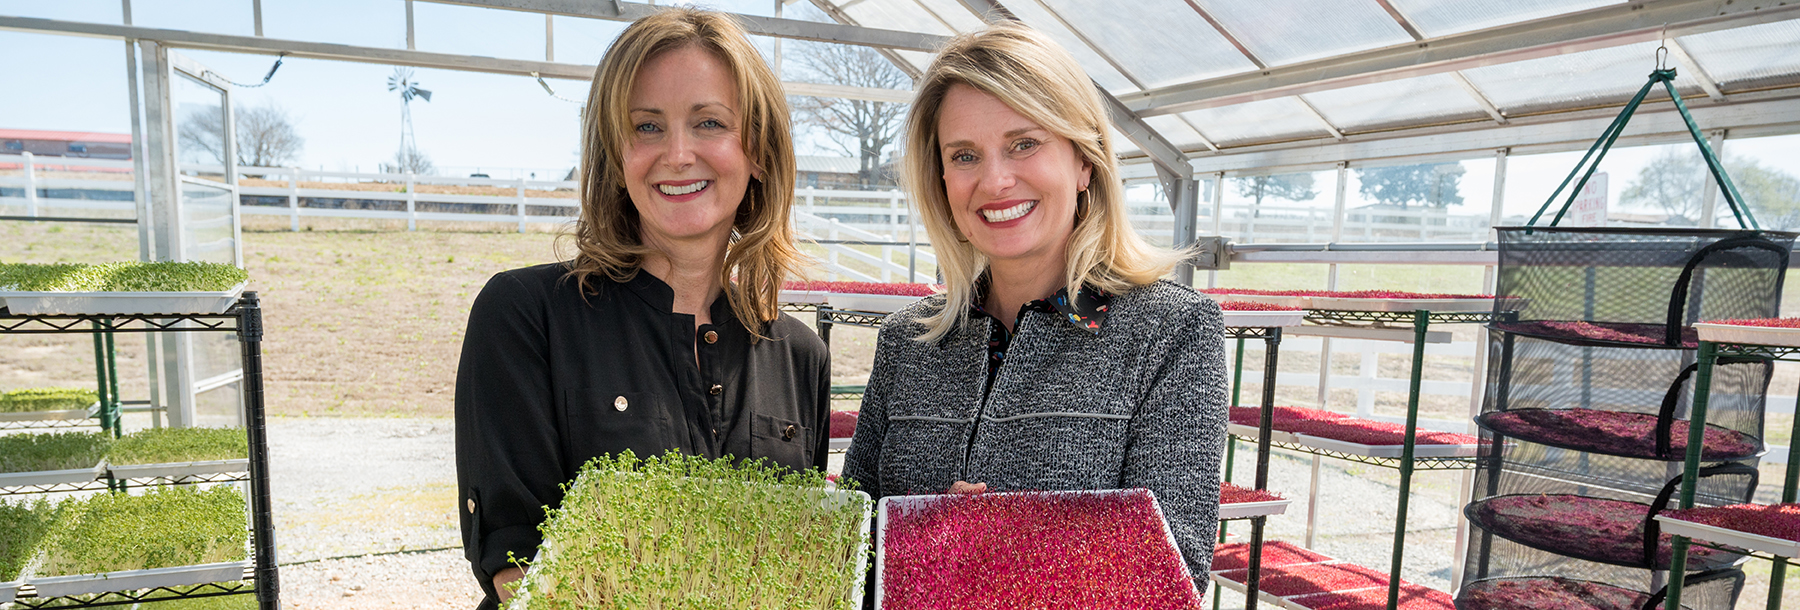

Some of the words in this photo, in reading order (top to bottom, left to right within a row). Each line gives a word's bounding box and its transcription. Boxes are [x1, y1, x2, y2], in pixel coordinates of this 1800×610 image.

[1584, 181, 1597, 195] NO
[1575, 196, 1604, 211] PARKING
[1582, 212, 1597, 223] FIRE
